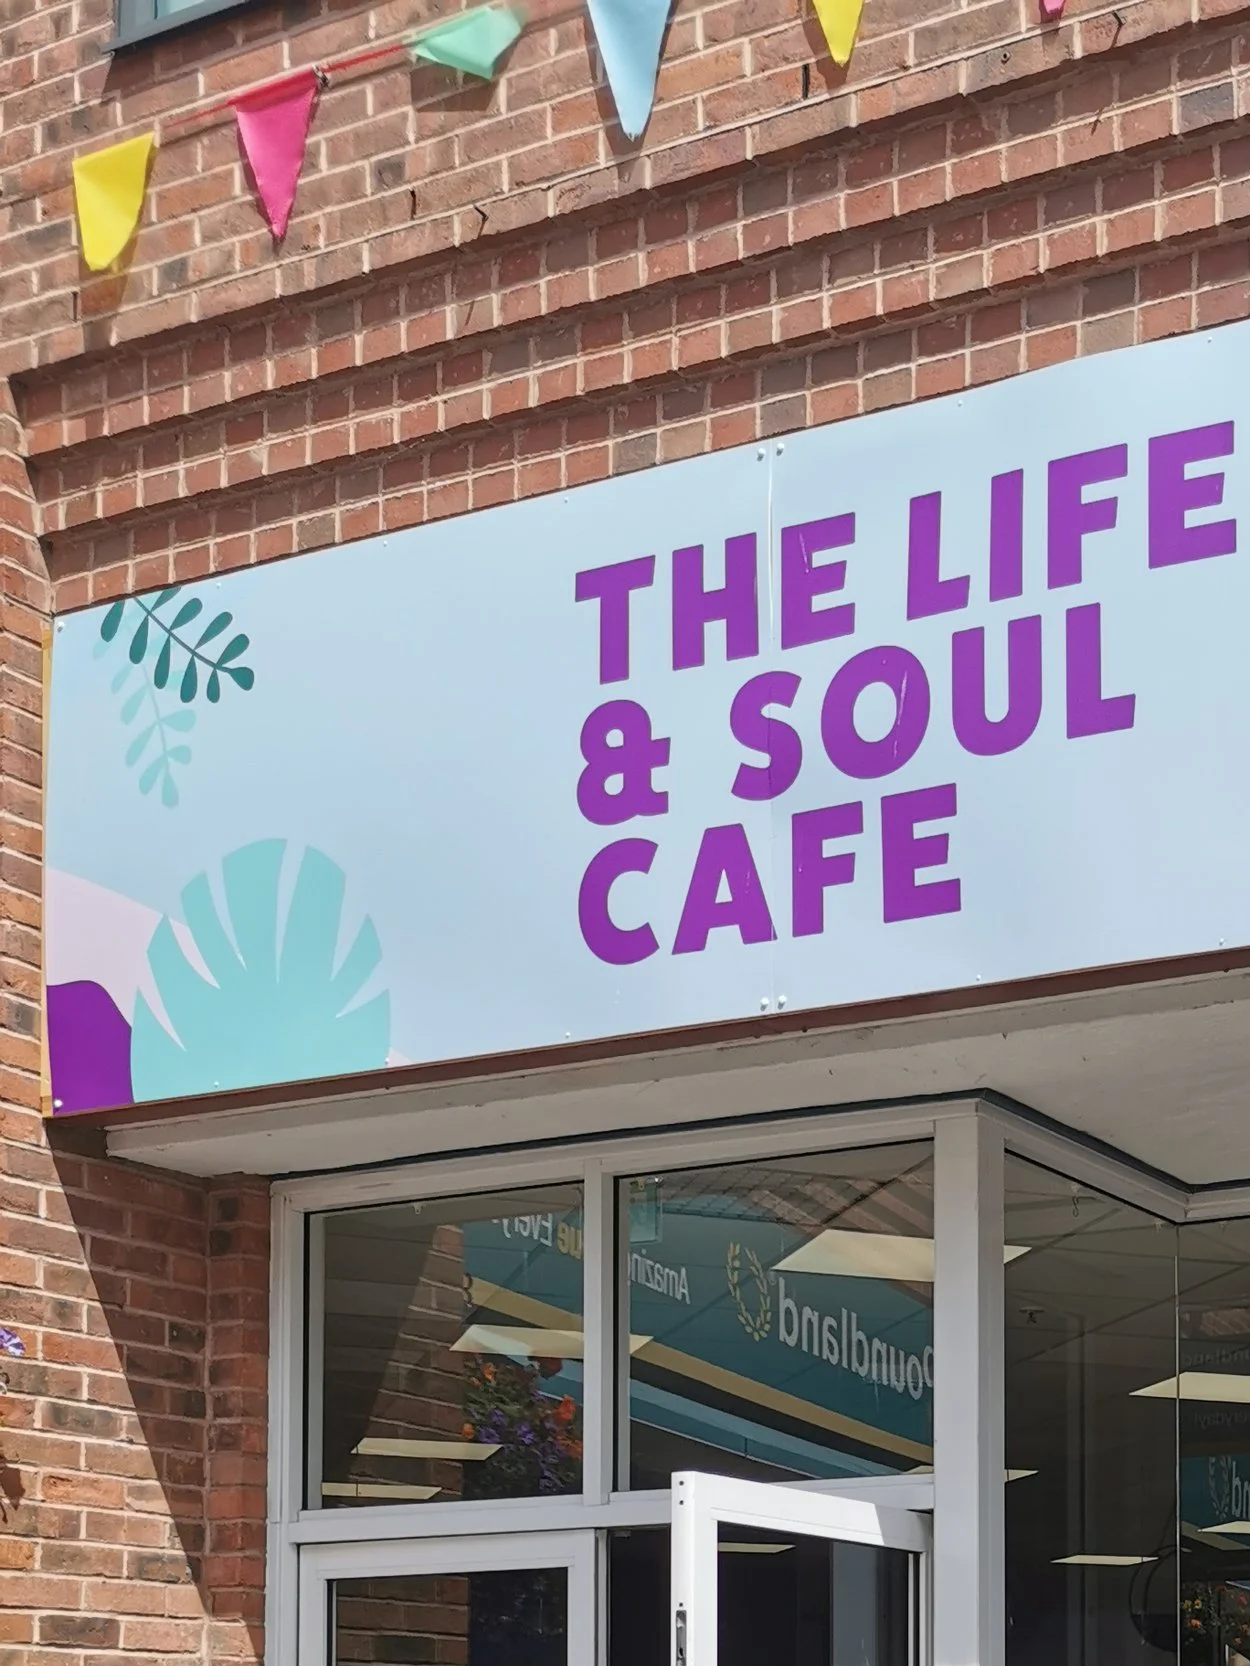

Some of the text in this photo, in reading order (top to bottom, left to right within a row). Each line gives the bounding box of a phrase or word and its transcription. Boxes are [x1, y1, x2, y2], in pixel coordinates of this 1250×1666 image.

[575, 420, 1237, 685] THE LIFE
[576, 602, 1136, 826] & SOUL
[577, 783, 962, 965] CAFE
